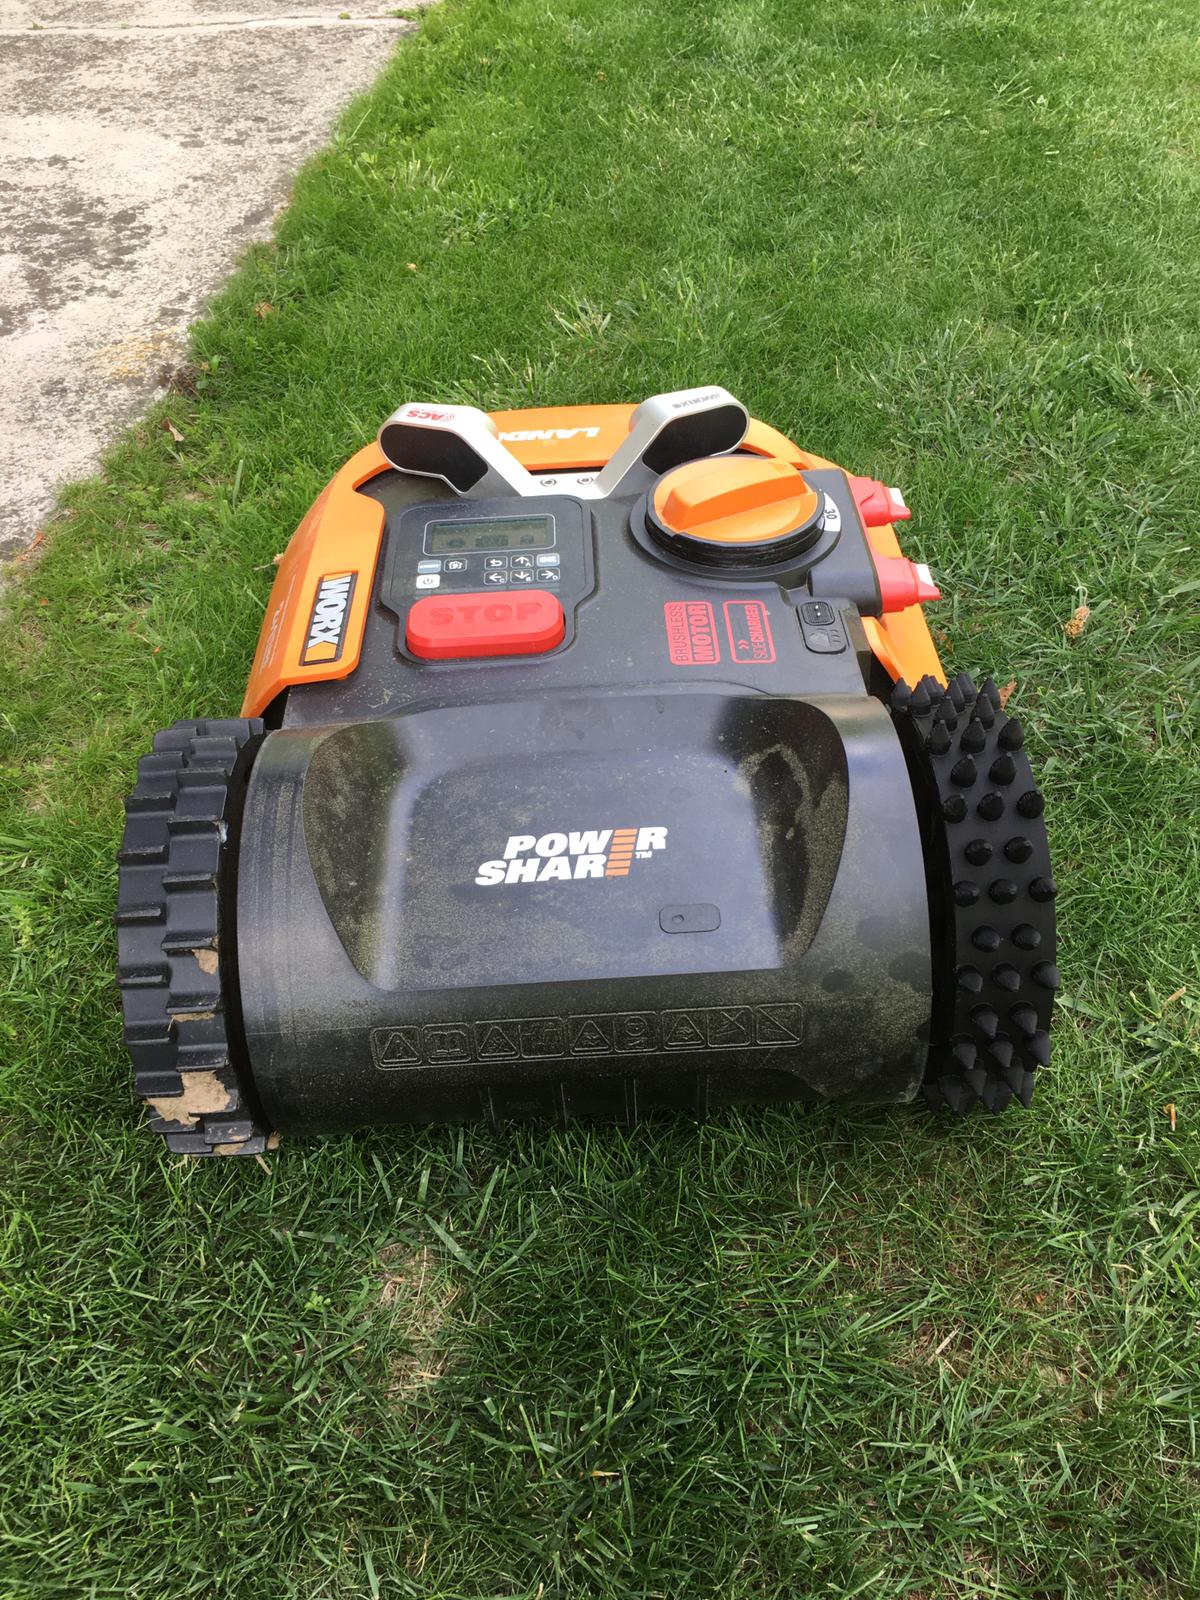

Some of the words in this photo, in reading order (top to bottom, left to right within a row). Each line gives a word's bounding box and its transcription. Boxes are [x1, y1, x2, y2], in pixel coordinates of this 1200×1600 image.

[406, 410, 445, 421] ACS
[824, 508, 837, 520] 30
[308, 575, 352, 649] WORX
[428, 602, 544, 626] STOP
[670, 604, 688, 662] BRUSHLESS
[687, 604, 715, 661] MOTOR
